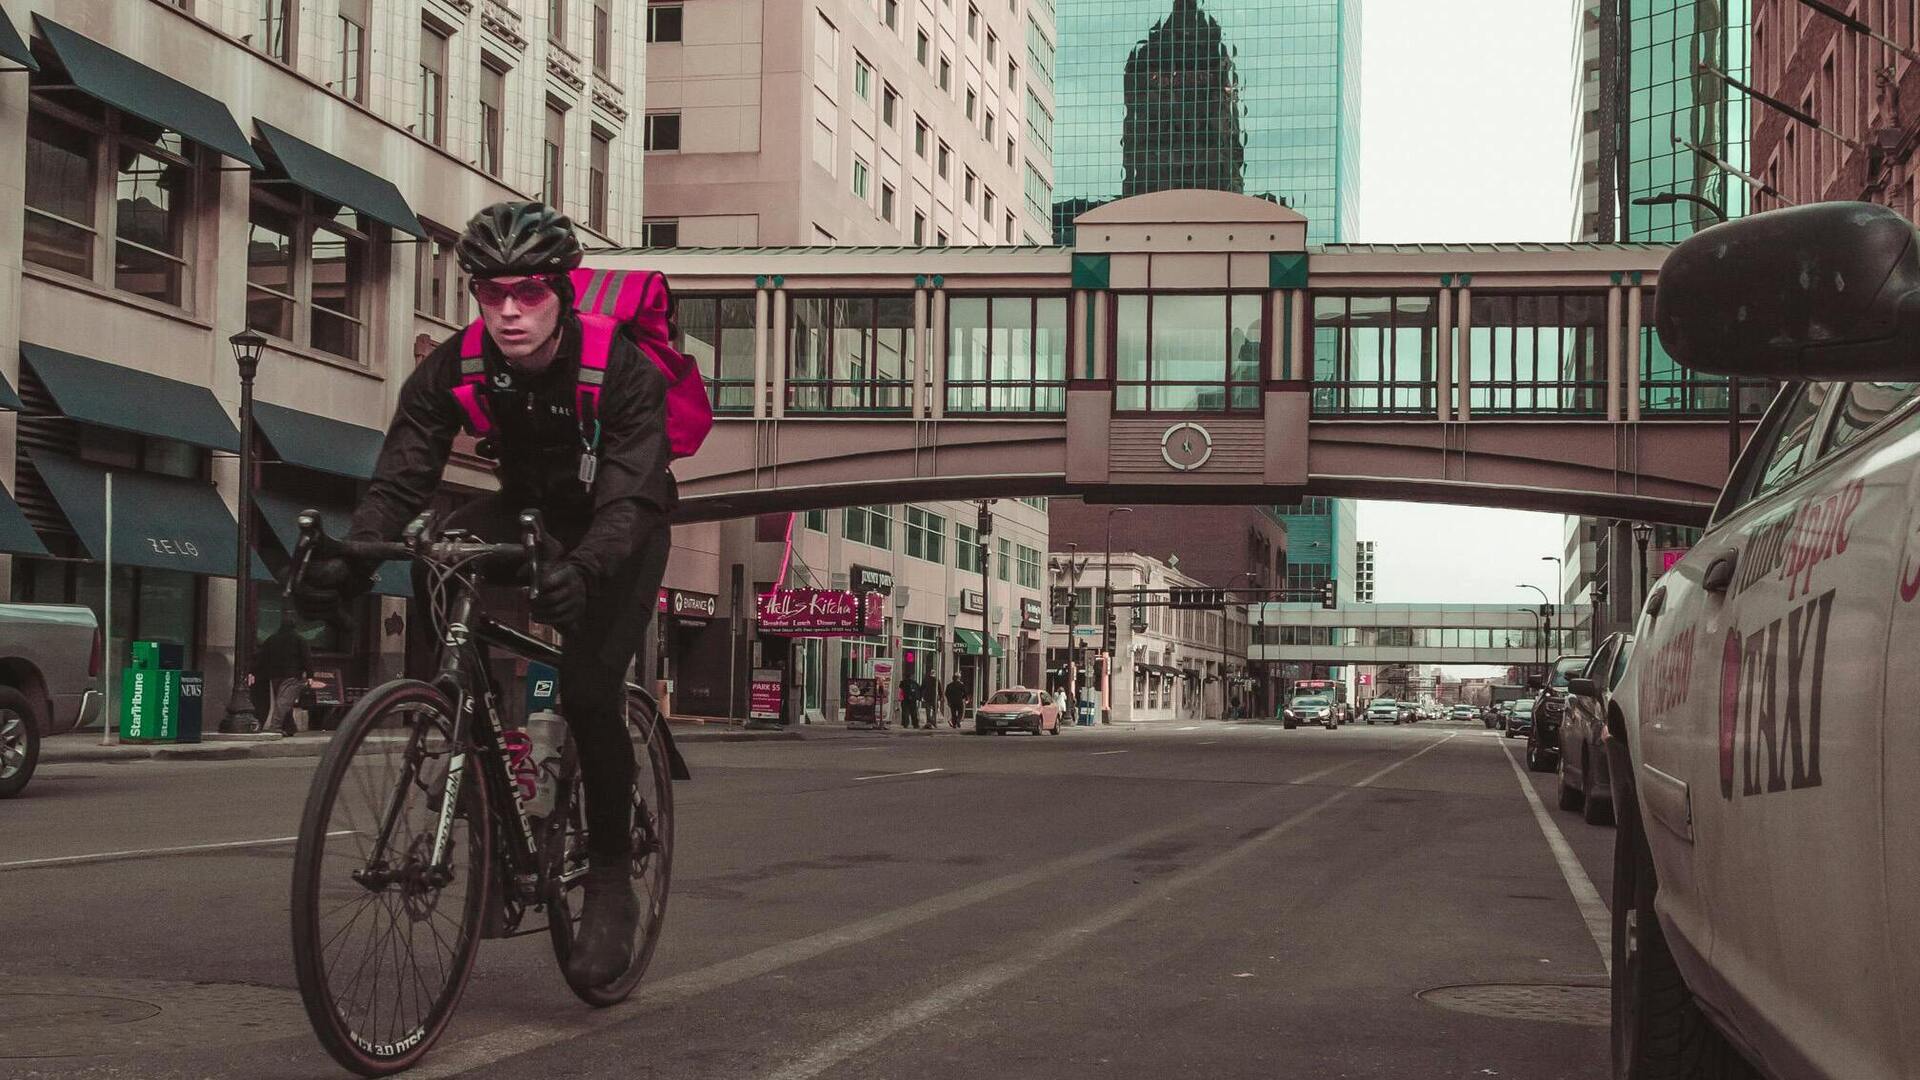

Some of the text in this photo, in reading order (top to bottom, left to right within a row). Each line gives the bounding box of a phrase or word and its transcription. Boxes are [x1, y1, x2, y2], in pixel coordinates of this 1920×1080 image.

[147, 538, 199, 556] ZELO
[764, 594, 808, 619] Hell's
[181, 684, 202, 697] NEWS
[1743, 588, 1836, 797] TAXI
[130, 672, 144, 737] StarTribune
